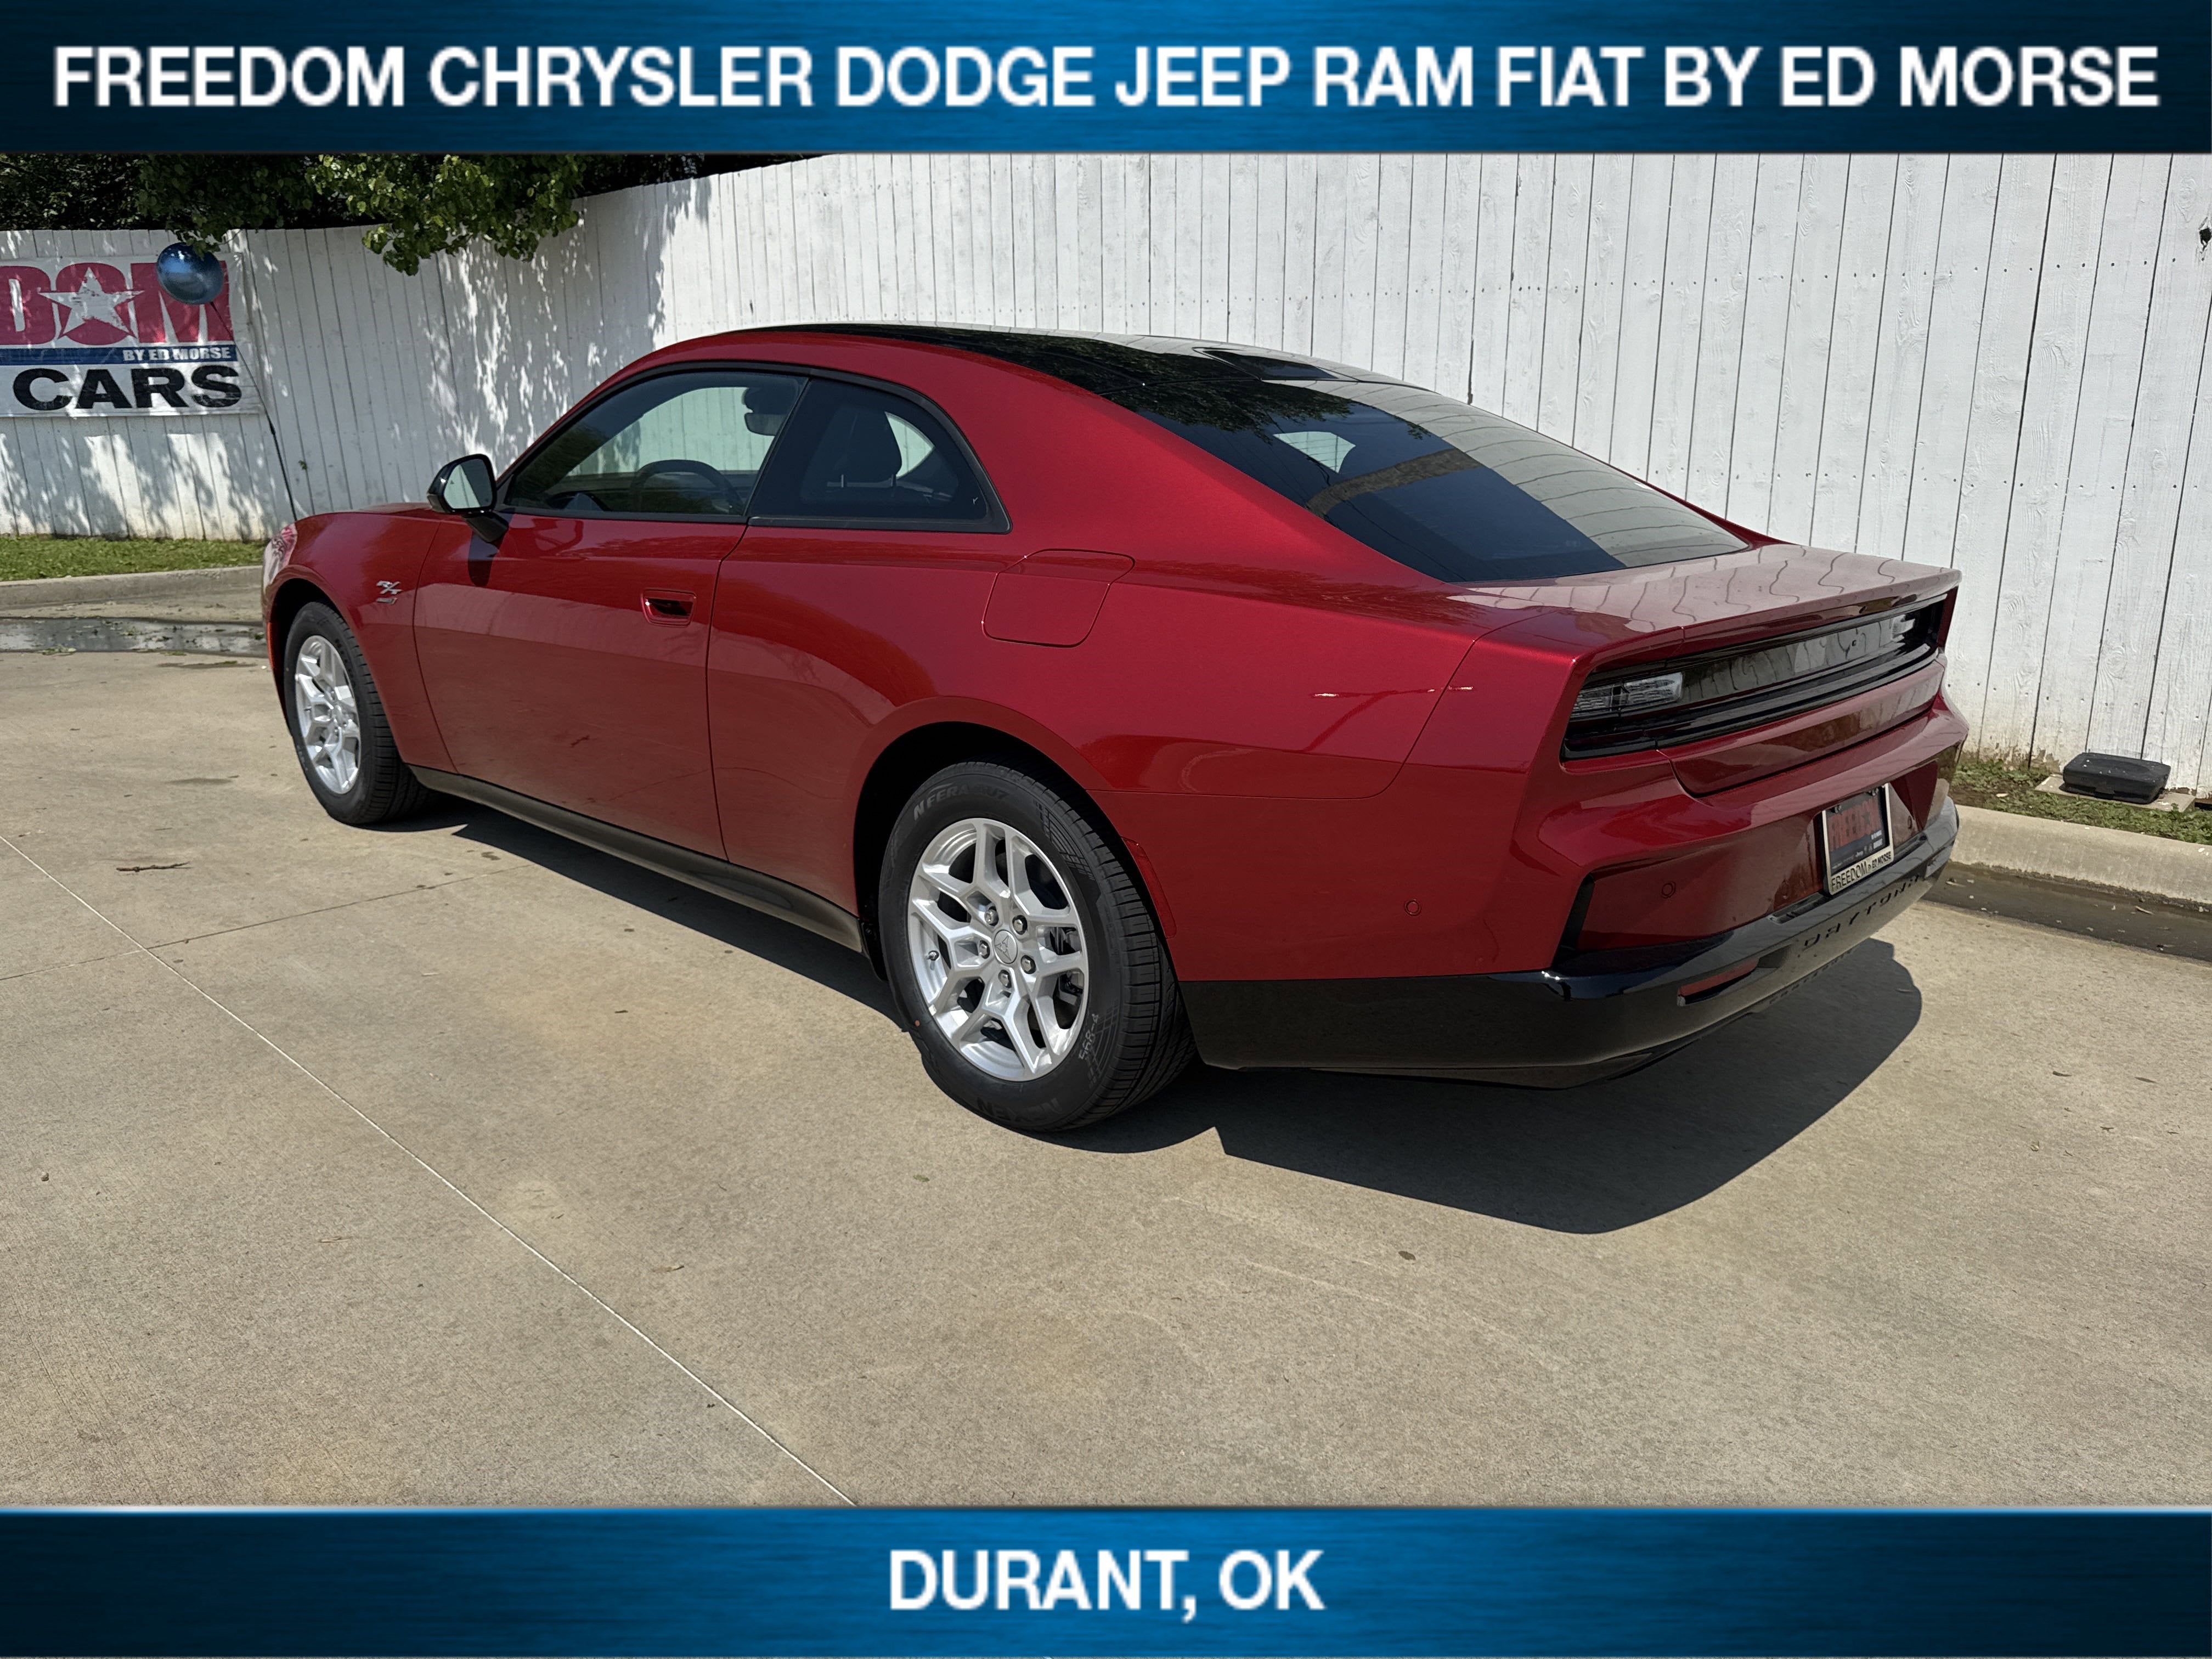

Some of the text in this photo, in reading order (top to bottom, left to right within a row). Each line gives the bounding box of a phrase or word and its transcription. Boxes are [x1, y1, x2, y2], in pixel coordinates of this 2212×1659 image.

[122, 347, 231, 361] BY ED MORSE
[13, 365, 242, 410] CARS
[1831, 860, 1868, 893] FREEDOM
